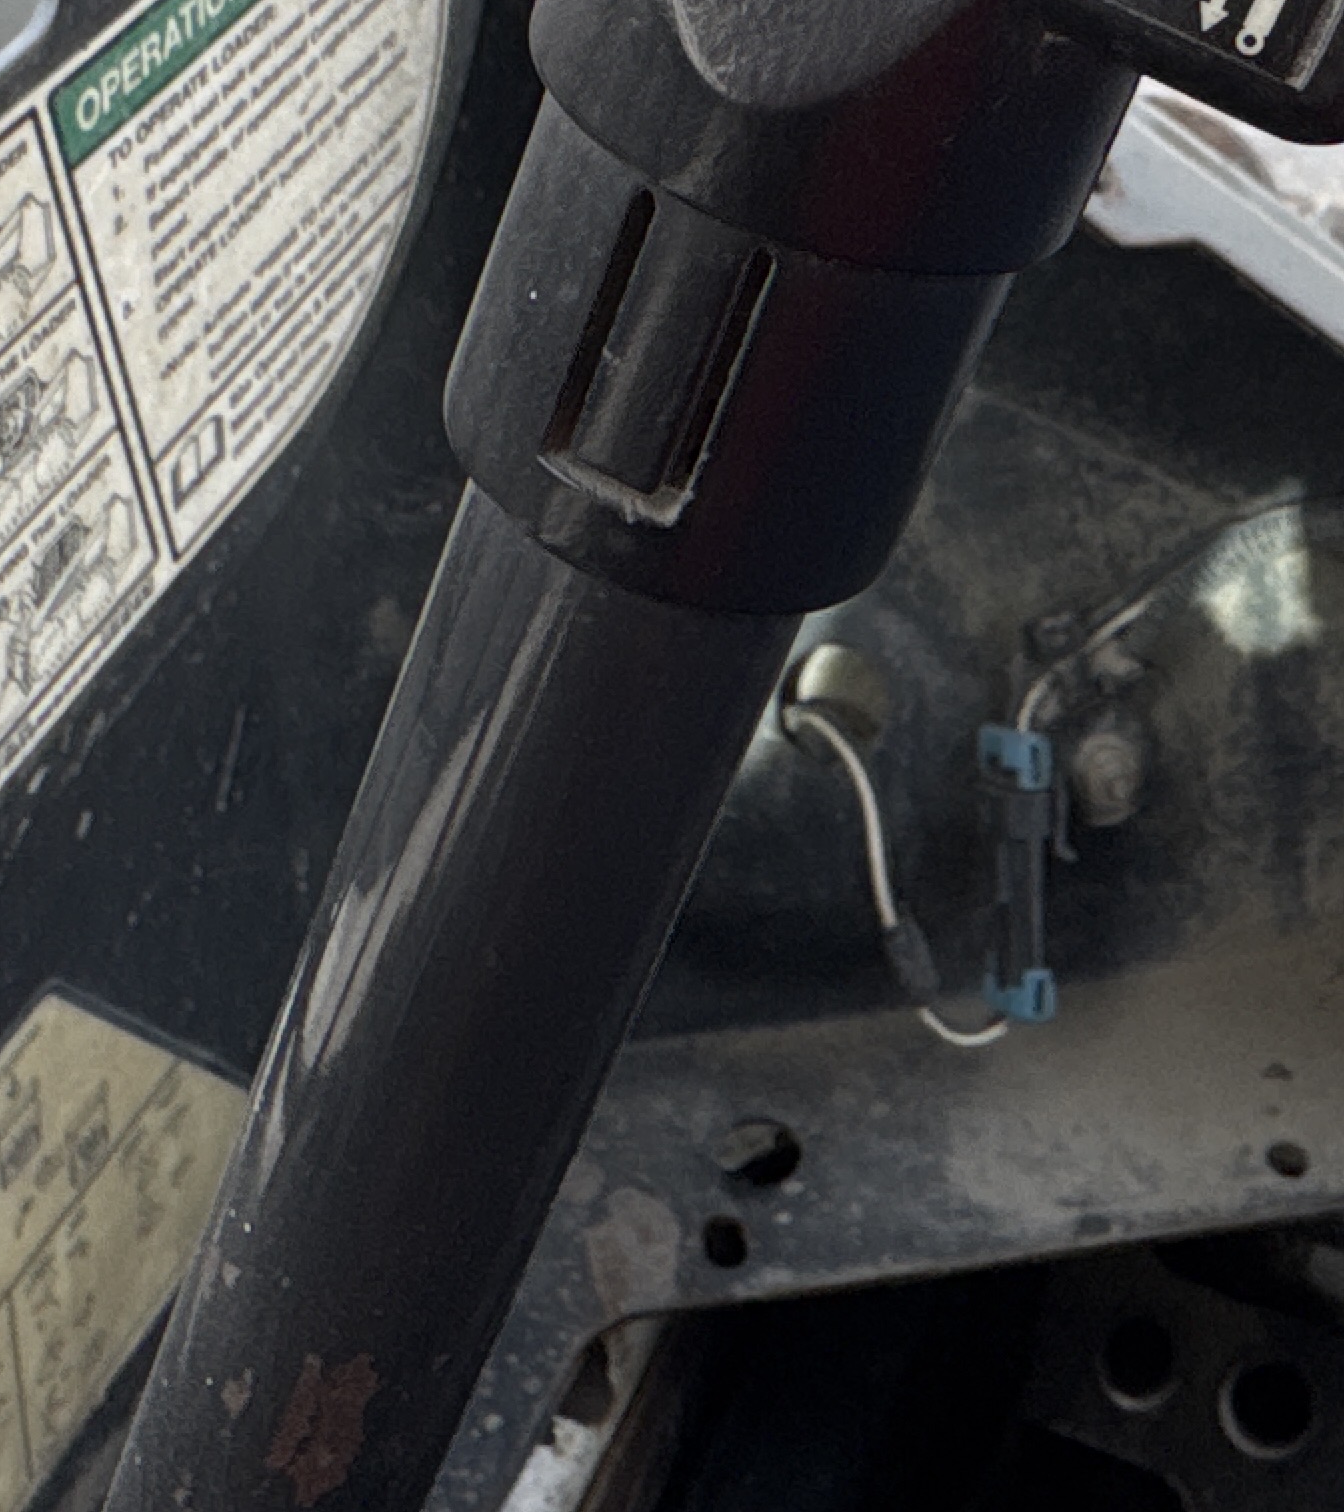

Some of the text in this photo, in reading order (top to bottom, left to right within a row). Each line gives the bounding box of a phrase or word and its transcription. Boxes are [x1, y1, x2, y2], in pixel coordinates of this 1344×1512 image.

[108, 132, 131, 173] TO
[136, 62, 208, 147] OPERATE
[18, 292, 78, 364] LOADER
